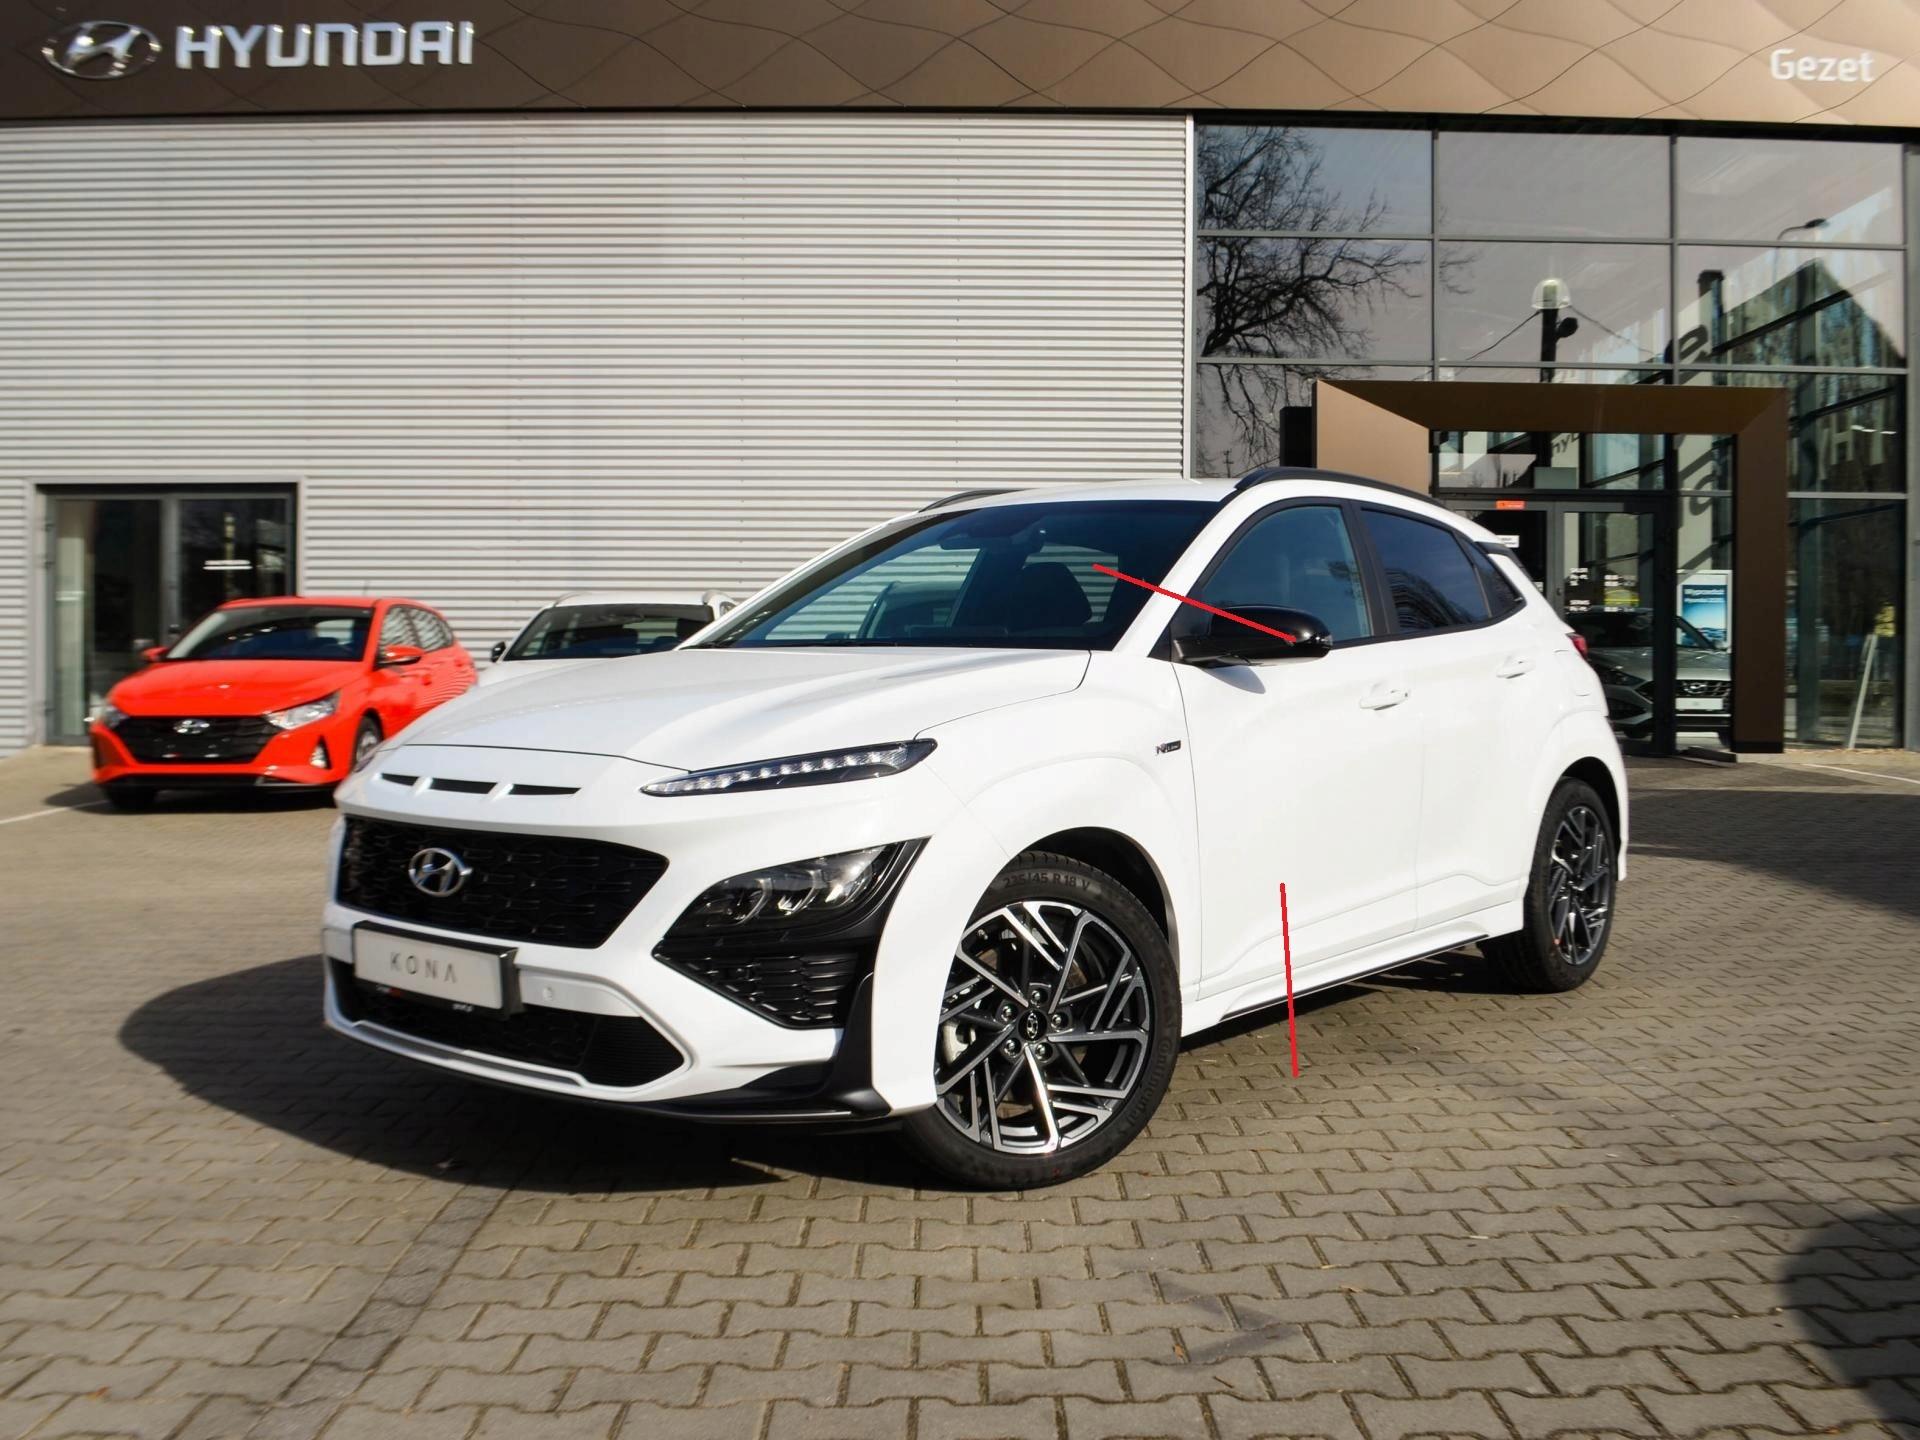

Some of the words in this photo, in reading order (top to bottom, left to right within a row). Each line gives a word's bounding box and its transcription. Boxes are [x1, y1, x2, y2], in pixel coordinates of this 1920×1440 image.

[175, 21, 474, 69] HYUNDAI
[1770, 48, 1875, 83] Gezet
[390, 951, 459, 984] KONA
